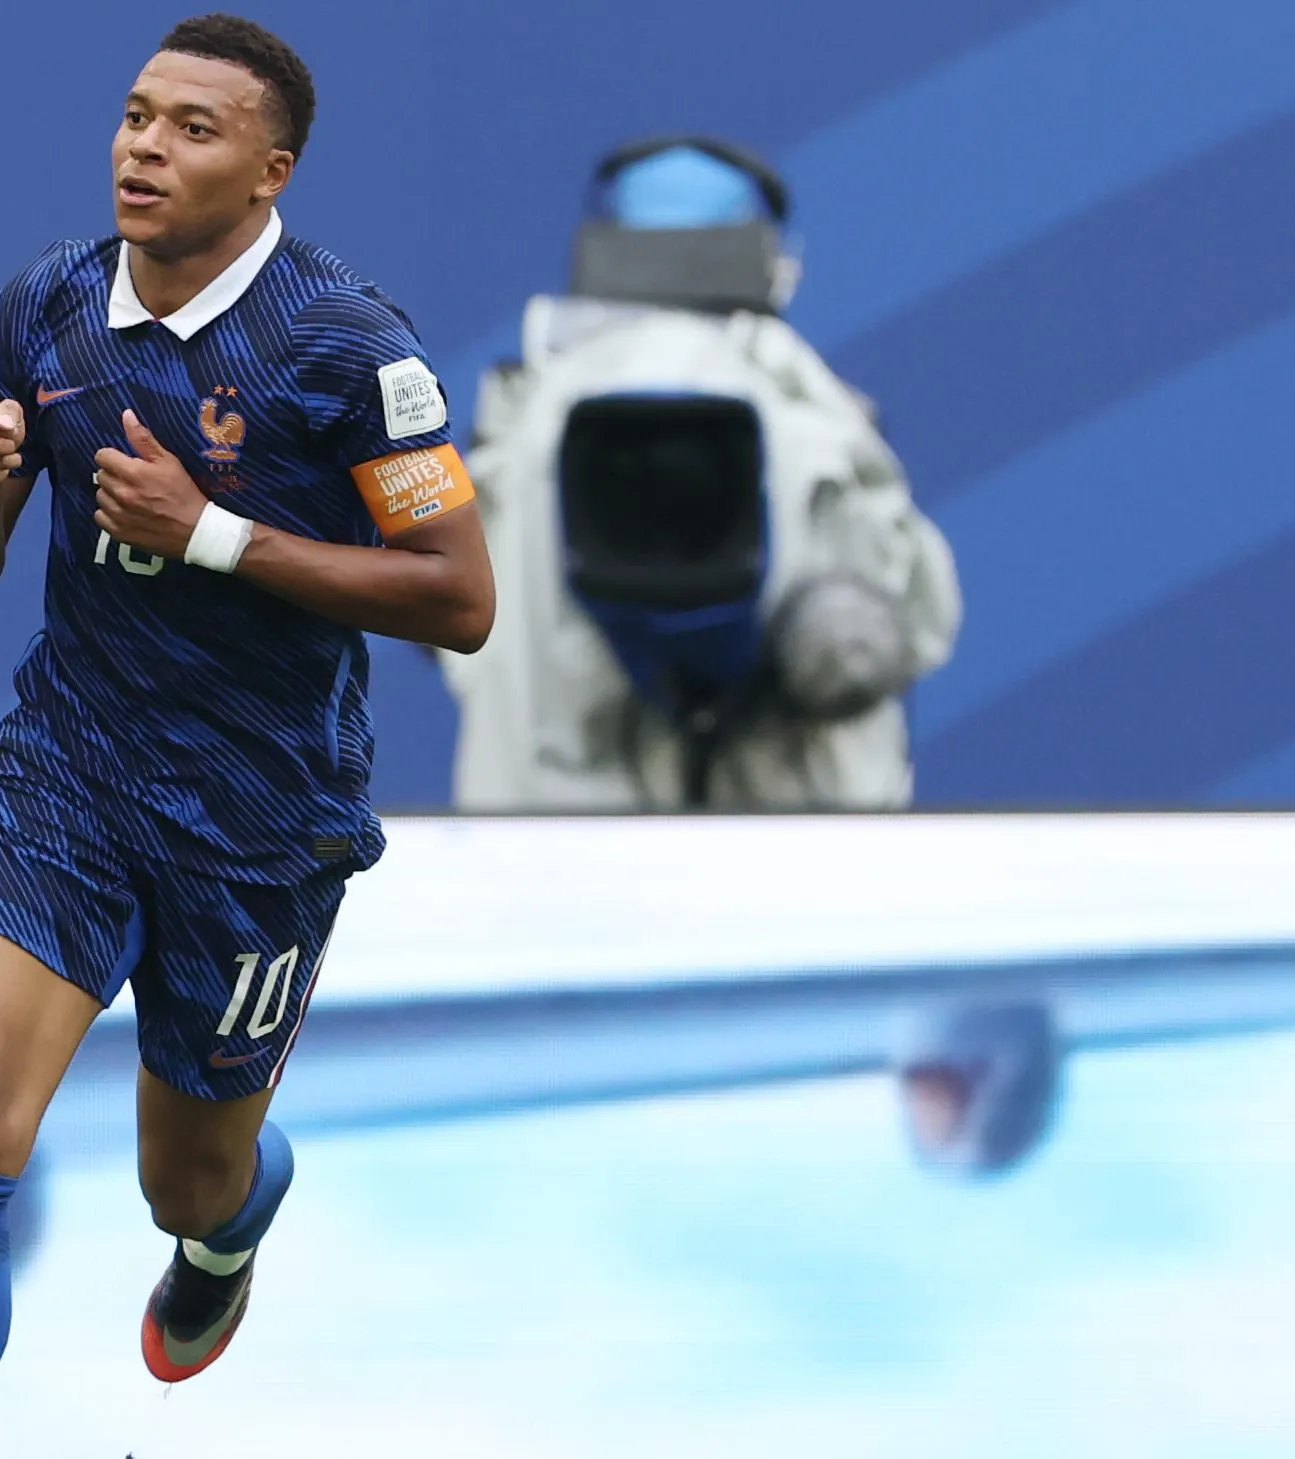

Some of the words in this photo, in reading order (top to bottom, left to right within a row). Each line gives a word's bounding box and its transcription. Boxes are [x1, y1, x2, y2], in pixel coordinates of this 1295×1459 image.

[392, 371, 426, 388] FOOTBALL
[394, 380, 431, 402] UNITES
[395, 404, 410, 417] the
[410, 396, 436, 412] World
[408, 413, 425, 422] FIFA
[373, 449, 434, 480] FOOTBALL
[379, 457, 445, 496] UNITES
[385, 496, 411, 514] the
[411, 472, 455, 504] World
[414, 502, 439, 517] FIFA
[216, 944, 299, 1040] 10
